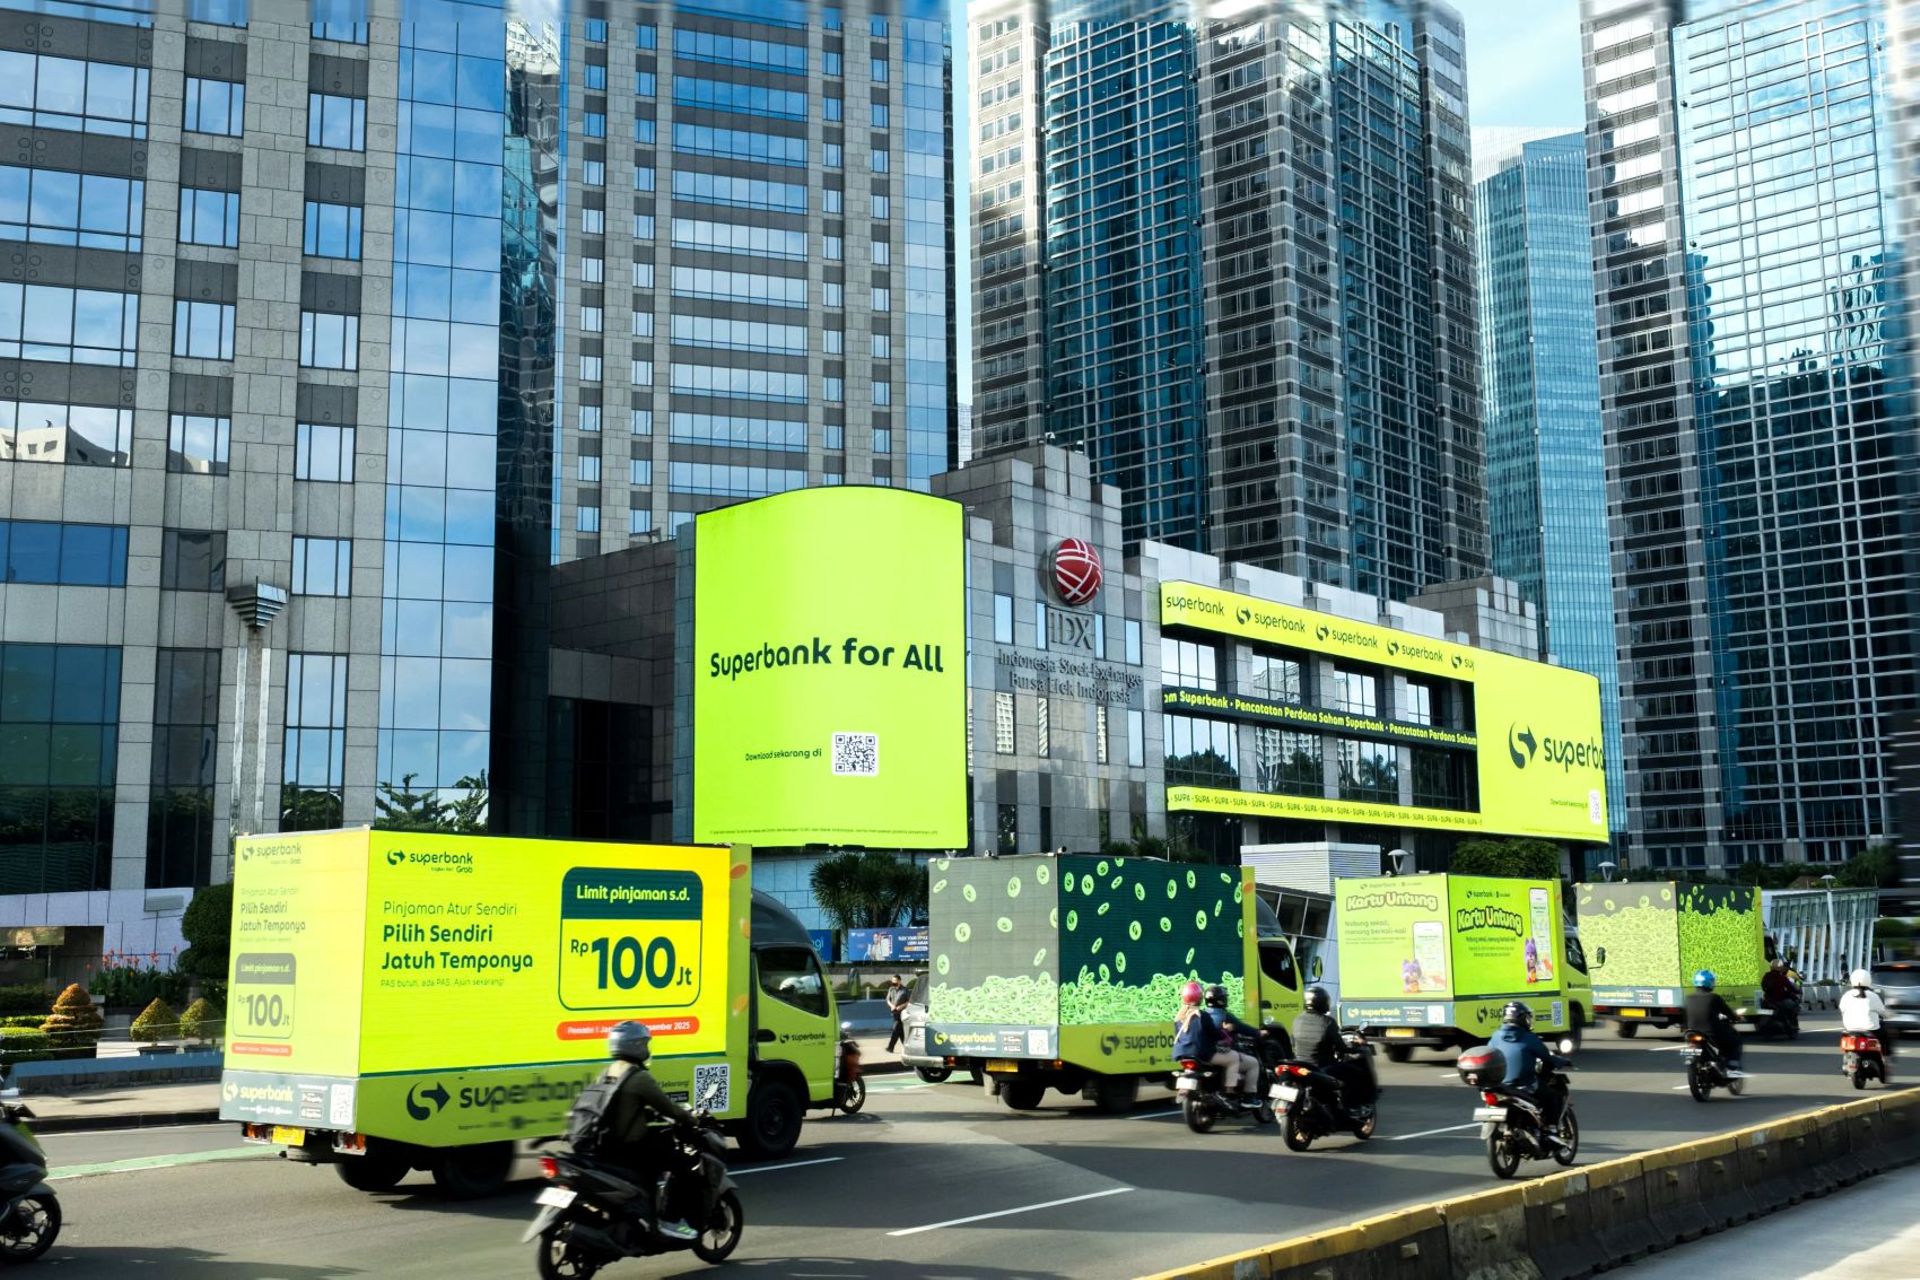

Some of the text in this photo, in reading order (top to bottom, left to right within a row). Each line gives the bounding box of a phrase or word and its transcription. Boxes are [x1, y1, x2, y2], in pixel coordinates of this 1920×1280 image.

[1050, 611, 1093, 650] IDX
[1166, 596, 1225, 616] superbank
[1254, 612, 1305, 633] superbank
[1332, 629, 1378, 648] superbank
[1402, 646, 1443, 662] superbank
[711, 637, 944, 681] Superbank for All
[998, 649, 1143, 689] Indonesia Stock Exchange
[1010, 671, 1044, 691] Bursa
[1077, 681, 1131, 703] Indonesia
[1180, 690, 1228, 709] Superbank
[1235, 699, 1283, 716] Pencatatan
[1284, 707, 1318, 722] Perdana
[1319, 713, 1344, 726] Saham
[1345, 717, 1384, 733] Superbank
[1389, 723, 1428, 738] Pencatatan
[1429, 729, 1455, 742] Perdana
[745, 748, 822, 762] Download sekarang di
[409, 850, 473, 865] superbank
[576, 884, 690, 904] Limit pinjaman s.d.
[1346, 891, 1439, 911] Kartu Untung
[259, 901, 288, 914] Sendiri
[383, 901, 517, 917] Pinjaman Atur Sendiri
[239, 919, 306, 934] Jatuh Temponya
[383, 924, 493, 942] Pilih Sendiri
[1457, 906, 1523, 937] Kartu Untung
[381, 951, 533, 972] Jatuh Temponya
[570, 936, 692, 990] Rp 100 Jt
[246, 993, 282, 1027] 100
[1124, 1030, 1174, 1053] superba
[239, 1083, 294, 1102] superbank
[459, 1072, 593, 1112] superban
